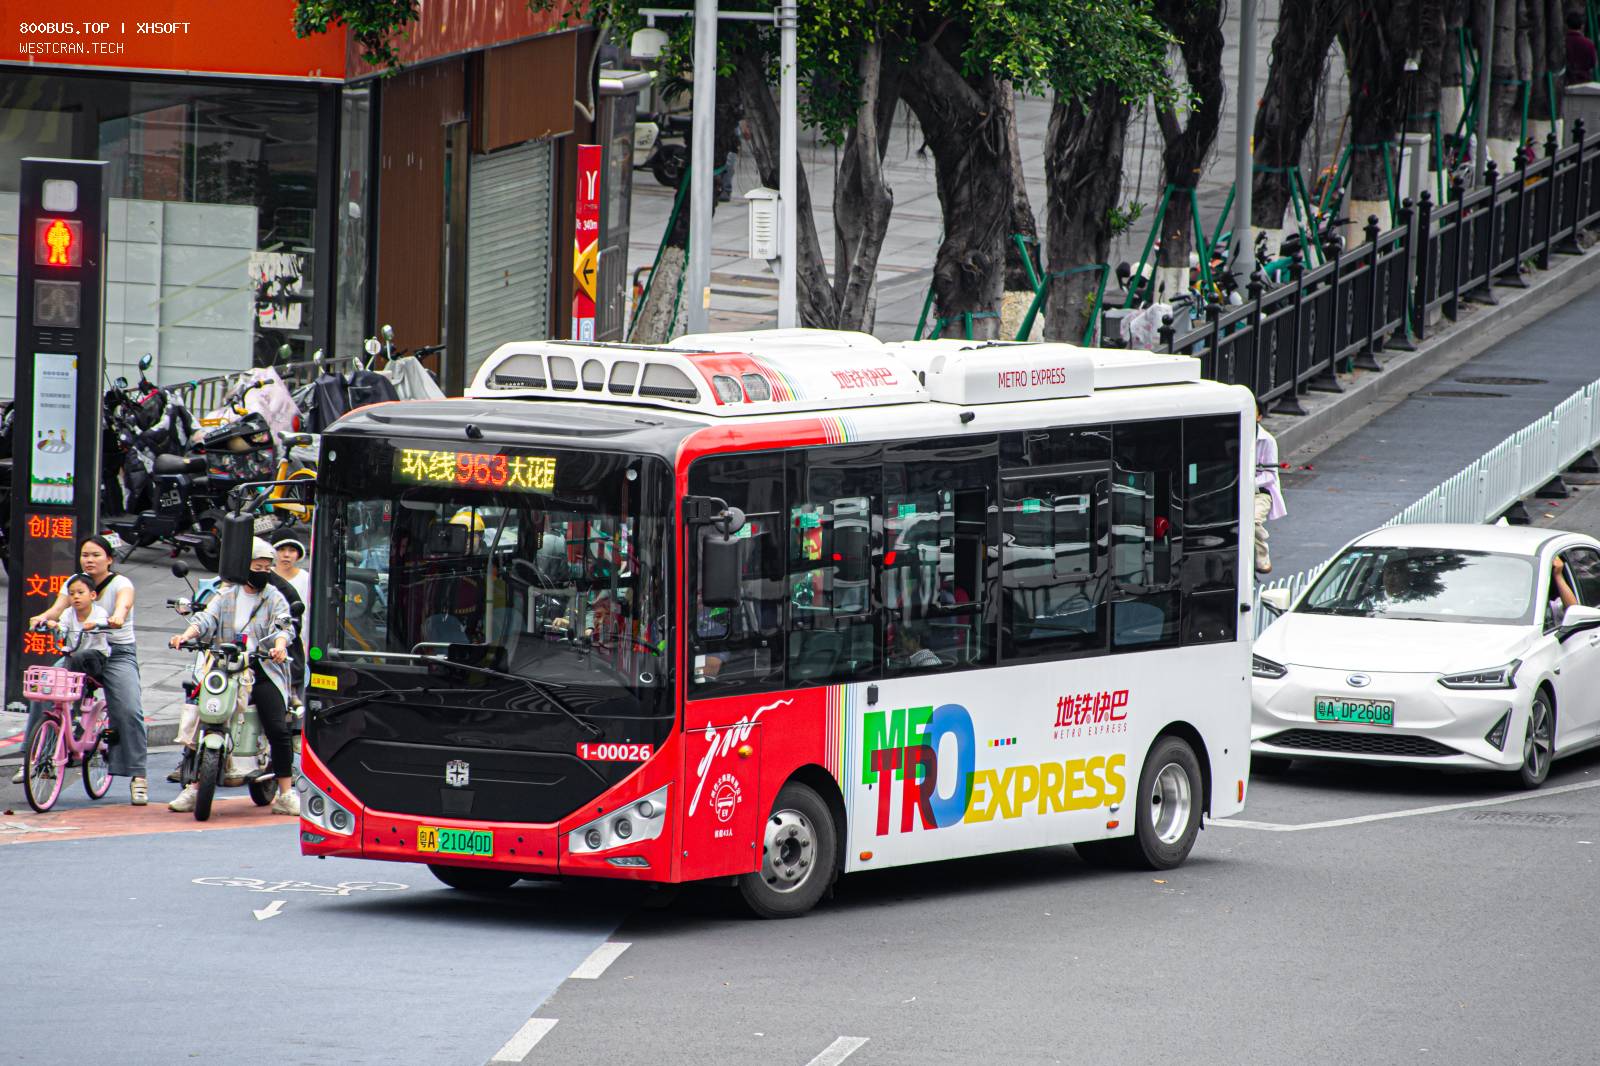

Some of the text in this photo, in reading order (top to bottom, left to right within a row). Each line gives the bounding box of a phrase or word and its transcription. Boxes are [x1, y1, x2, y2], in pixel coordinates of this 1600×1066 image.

[830, 367, 898, 389] 地铁快巴
[998, 367, 1066, 389] METRO EXPRESS
[27, 515, 73, 539] 创建
[1054, 689, 1129, 727] 地铁快巴
[1054, 722, 1128, 740] METRO EXPRESS
[580, 743, 651, 761] 1-00026
[963, 753, 1126, 825] EXPRESS
